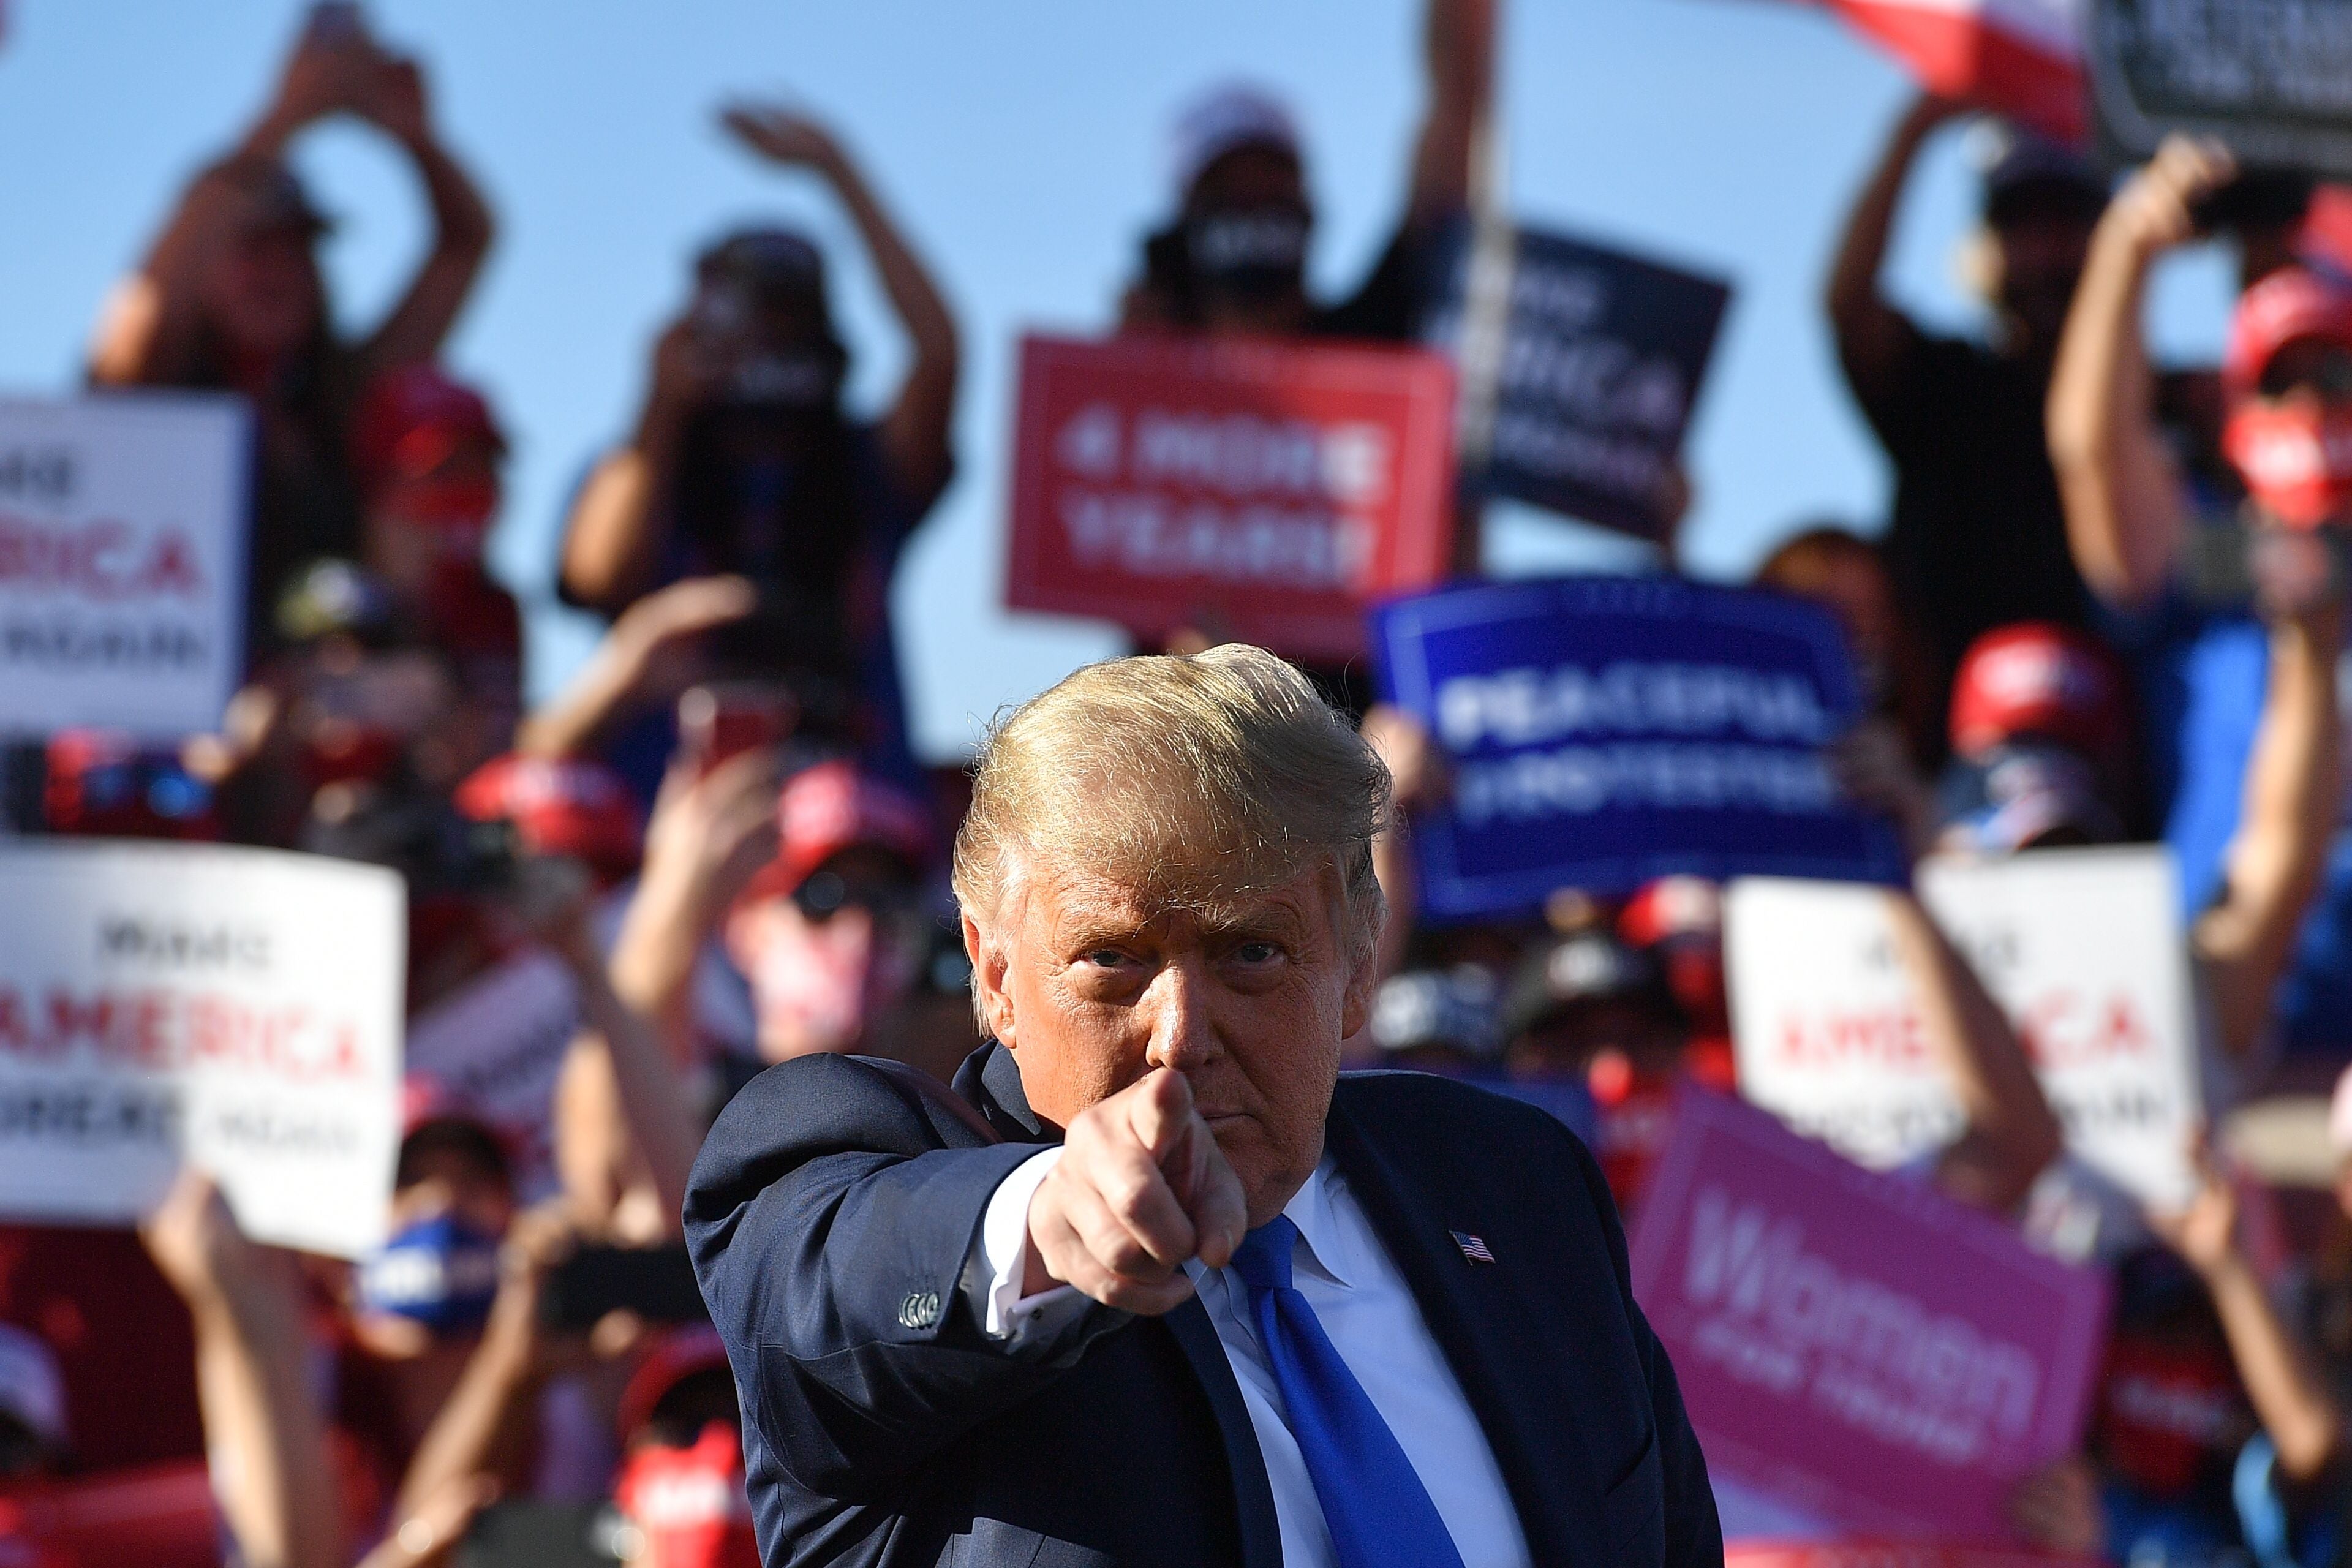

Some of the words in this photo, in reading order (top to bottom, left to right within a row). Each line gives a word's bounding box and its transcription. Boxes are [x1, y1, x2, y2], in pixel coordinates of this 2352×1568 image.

[1057, 404, 1122, 478] 4
[1133, 409, 1393, 501] MORE
[1436, 662, 1826, 748] PEACEFUL
[96, 914, 276, 973] MAKE
[1684, 1186, 2038, 1439] Women
